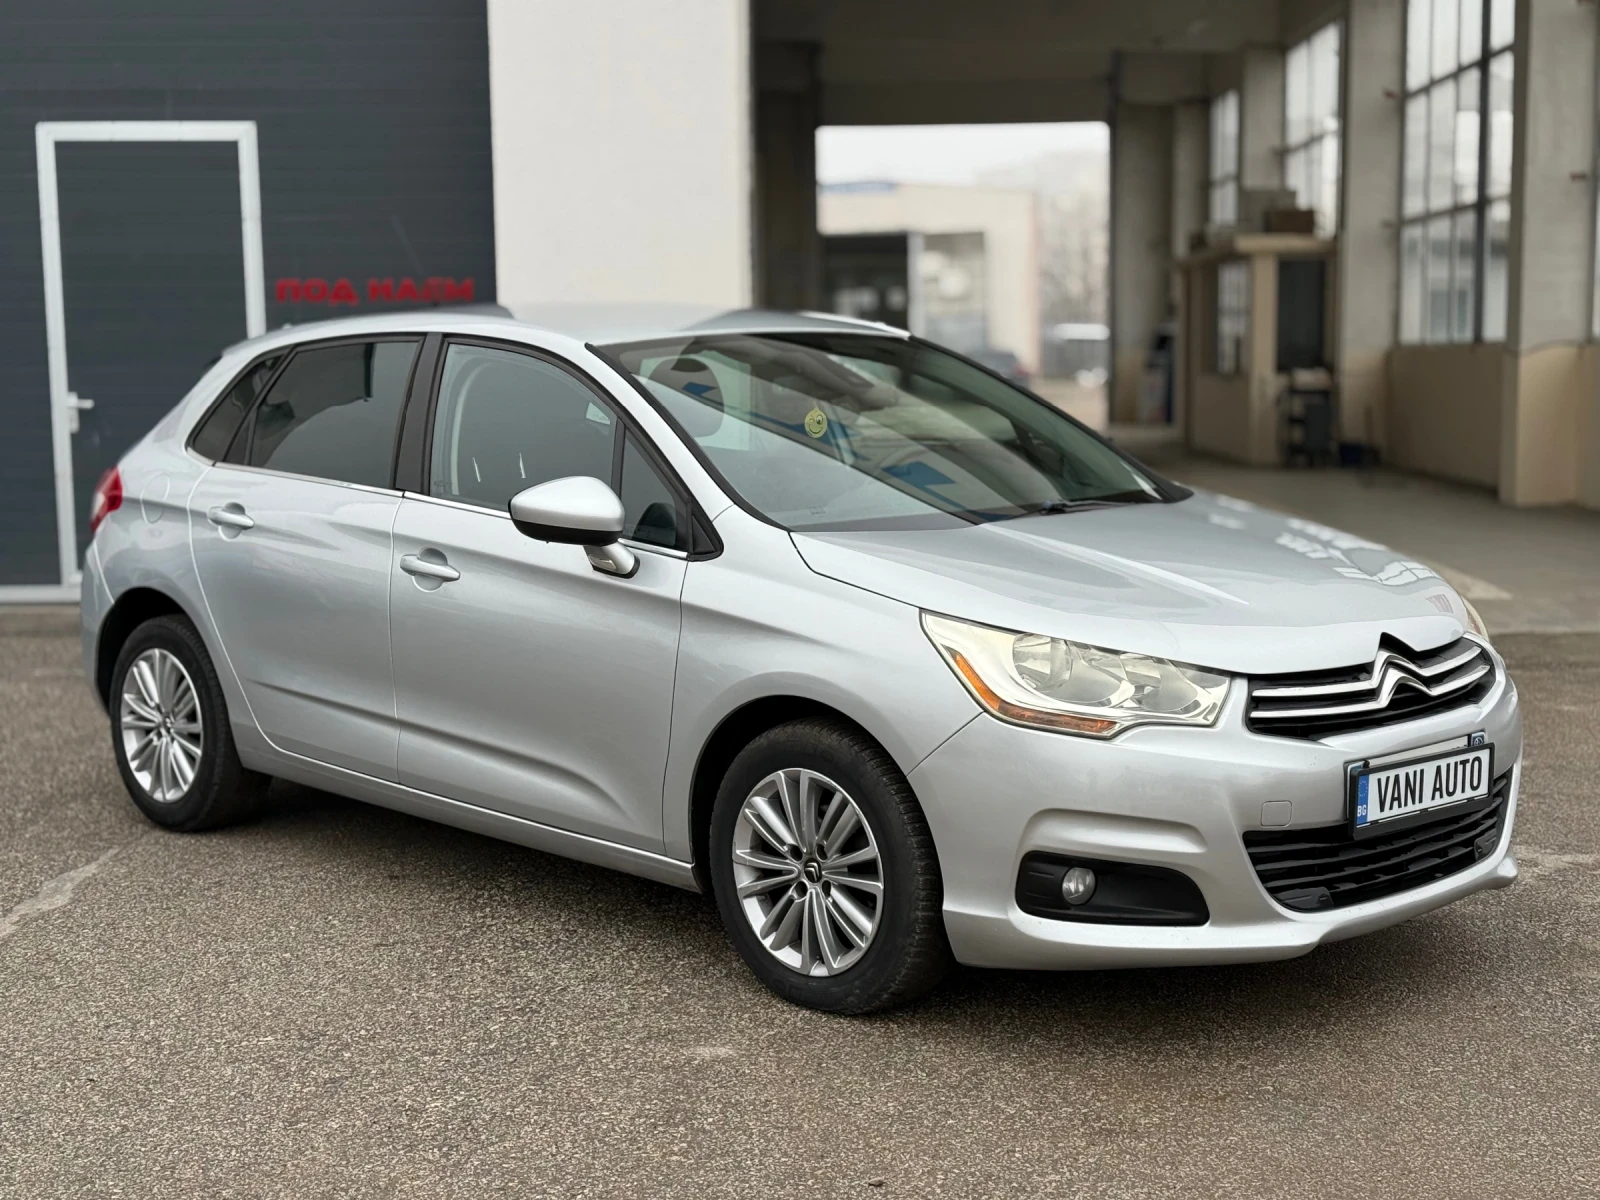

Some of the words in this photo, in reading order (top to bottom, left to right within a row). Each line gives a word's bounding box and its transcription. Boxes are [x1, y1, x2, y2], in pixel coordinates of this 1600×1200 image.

[275, 277, 359, 306] ПОД
[1377, 768, 1424, 813] VANI
[1431, 756, 1483, 801] AUTO
[1357, 804, 1367, 818] BG
